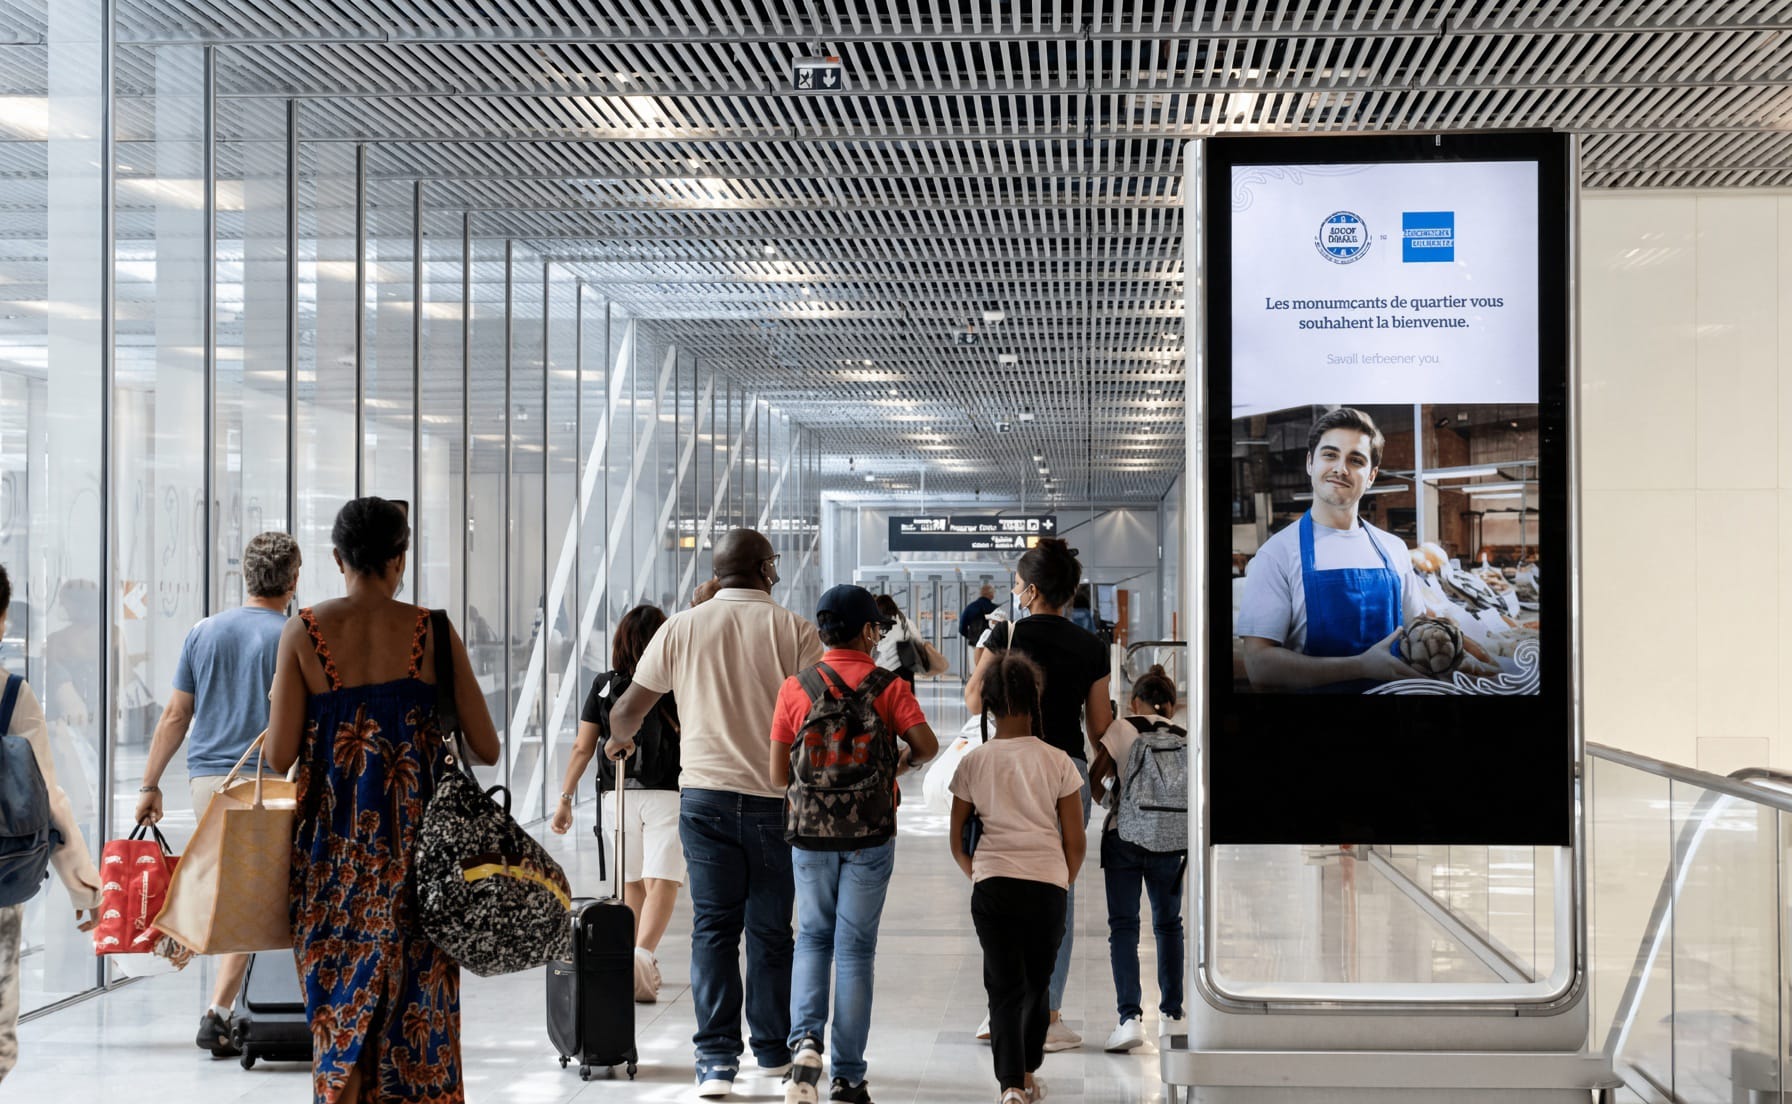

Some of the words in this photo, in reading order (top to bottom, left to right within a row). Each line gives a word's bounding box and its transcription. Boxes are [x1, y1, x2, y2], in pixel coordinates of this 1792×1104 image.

[1265, 297, 1290, 310] Les
[1390, 295, 1408, 309] de
[1410, 295, 1467, 311] quartier
[1470, 297, 1504, 308] vous
[1299, 316, 1374, 329] souhahent
[1376, 316, 1390, 329] la
[1392, 316, 1470, 329] bienvenue.
